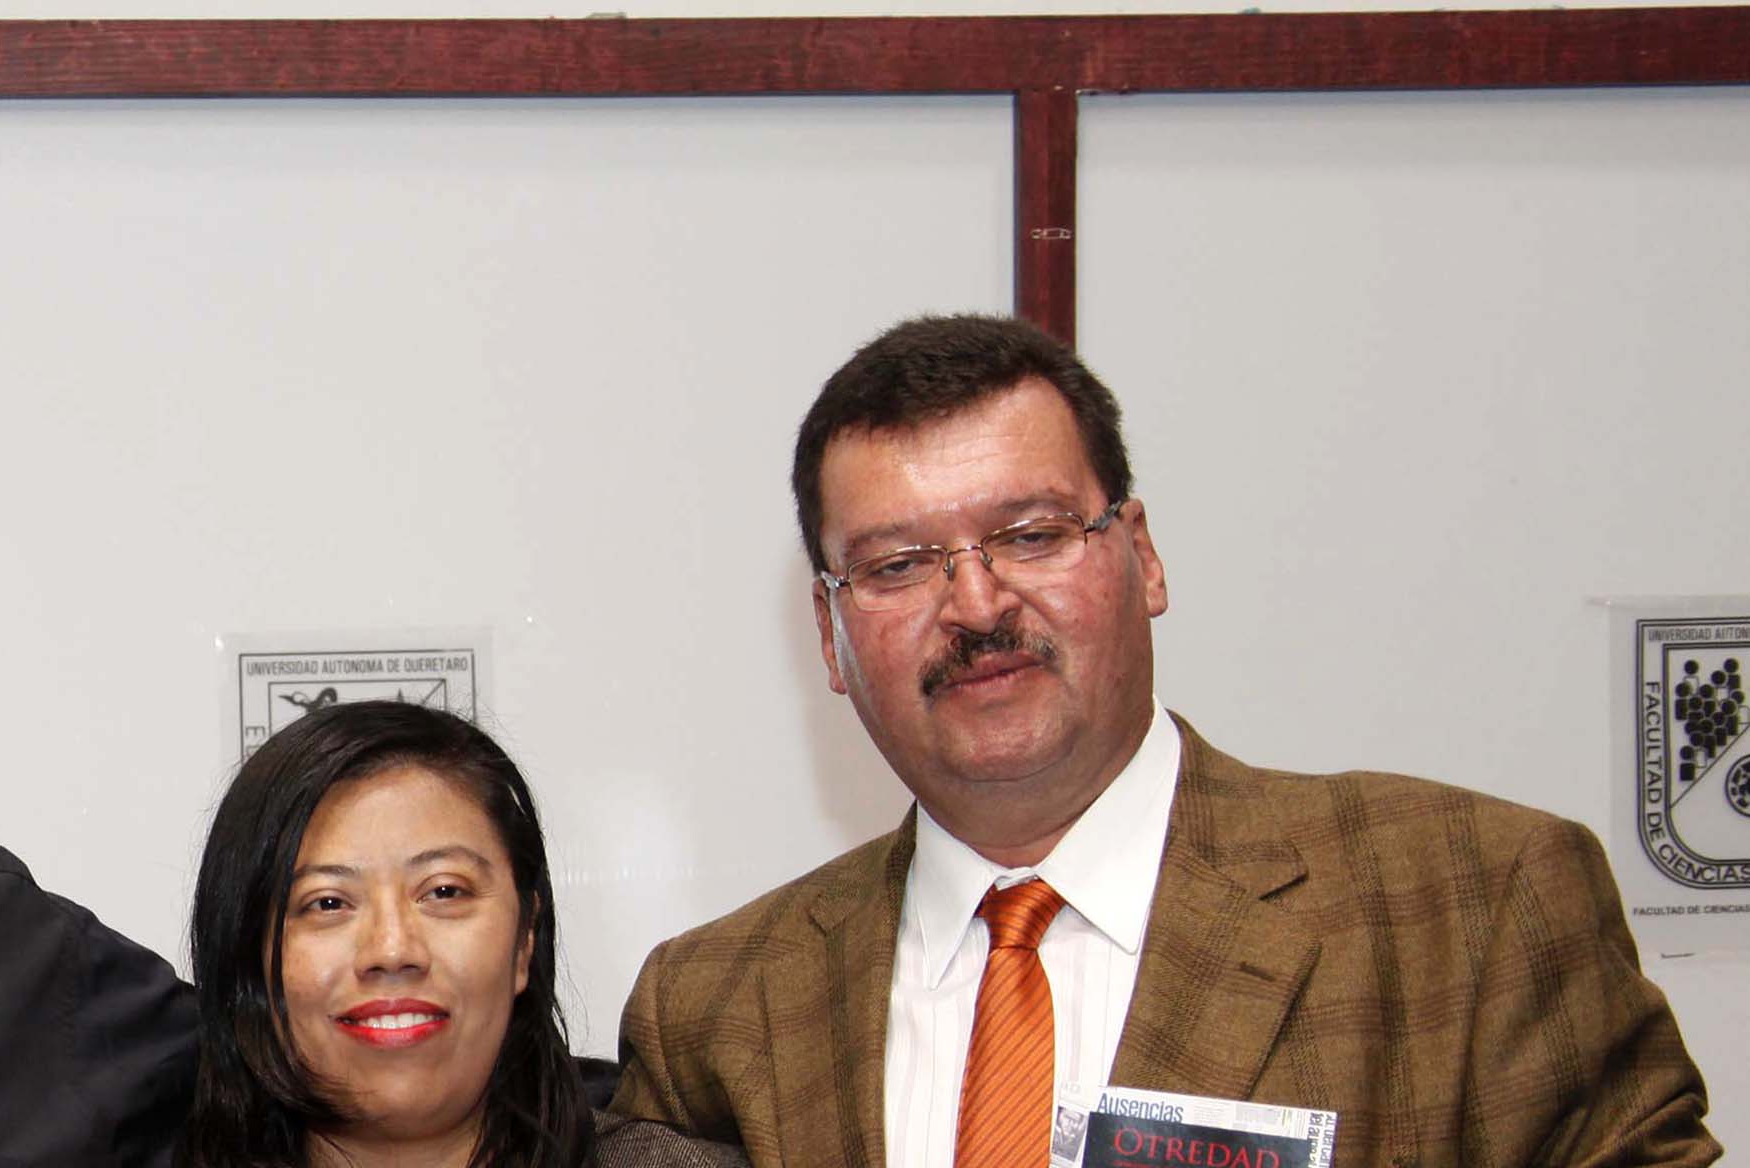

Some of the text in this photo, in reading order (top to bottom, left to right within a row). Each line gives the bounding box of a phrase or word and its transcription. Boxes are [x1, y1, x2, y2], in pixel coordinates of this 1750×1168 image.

[1649, 628, 1711, 641] UNIVERSIDAD
[246, 656, 468, 676] UNIVERSIDAD AUTONOMA DE QUERETARO
[1645, 682, 1750, 883] FACULTAD DE CIENCIAS
[1633, 906, 1685, 917] FACULTAD
[1687, 904, 1700, 914] DE
[1097, 1092, 1184, 1124] Ausencias
